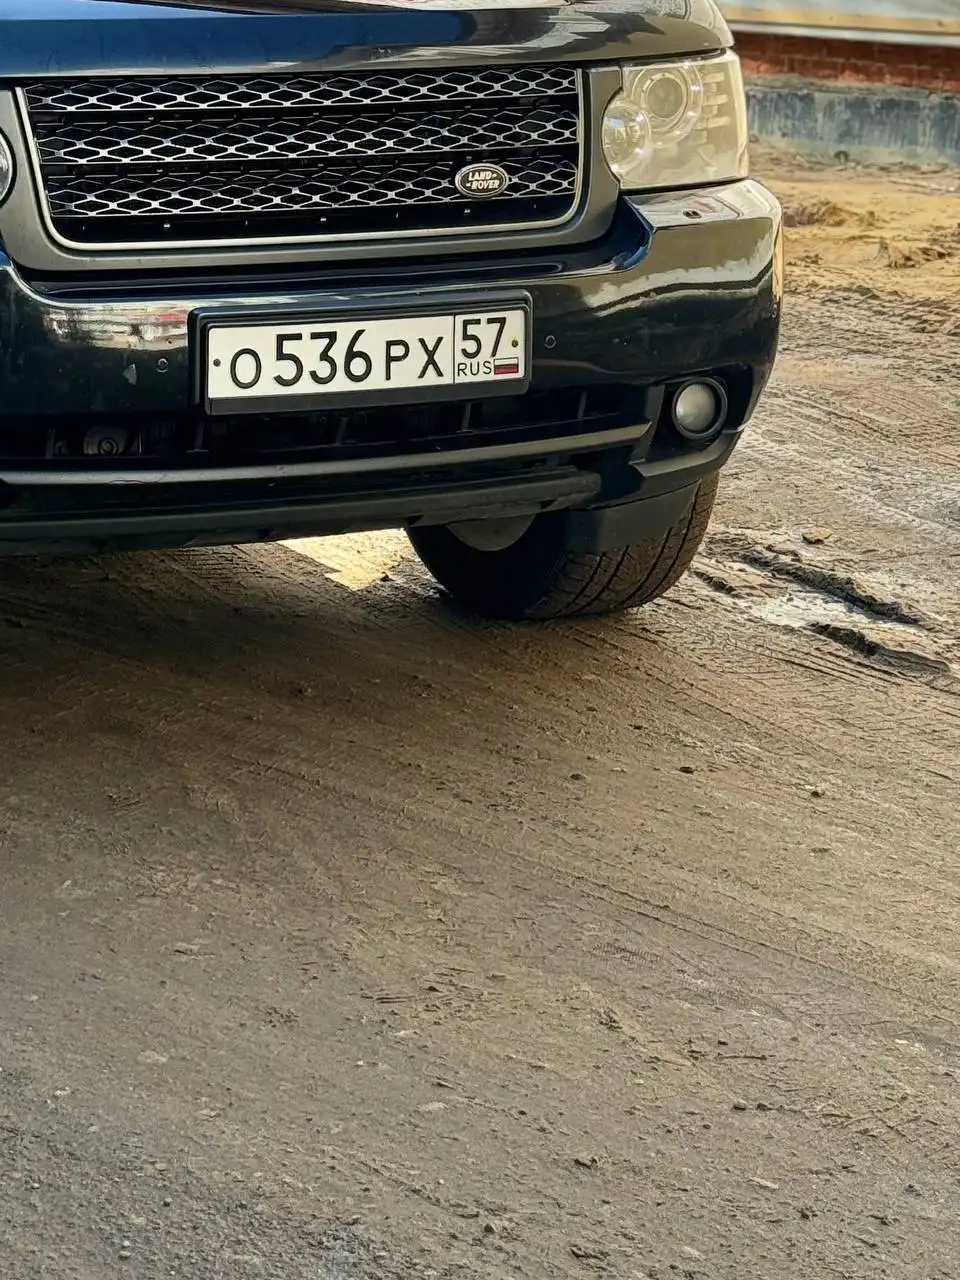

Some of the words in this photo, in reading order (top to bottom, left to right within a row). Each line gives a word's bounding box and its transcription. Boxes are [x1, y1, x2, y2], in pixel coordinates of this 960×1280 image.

[468, 171, 492, 181] LAND
[471, 180, 500, 190] ROVER
[461, 317, 507, 359] 57
[457, 361, 493, 377] RUS
